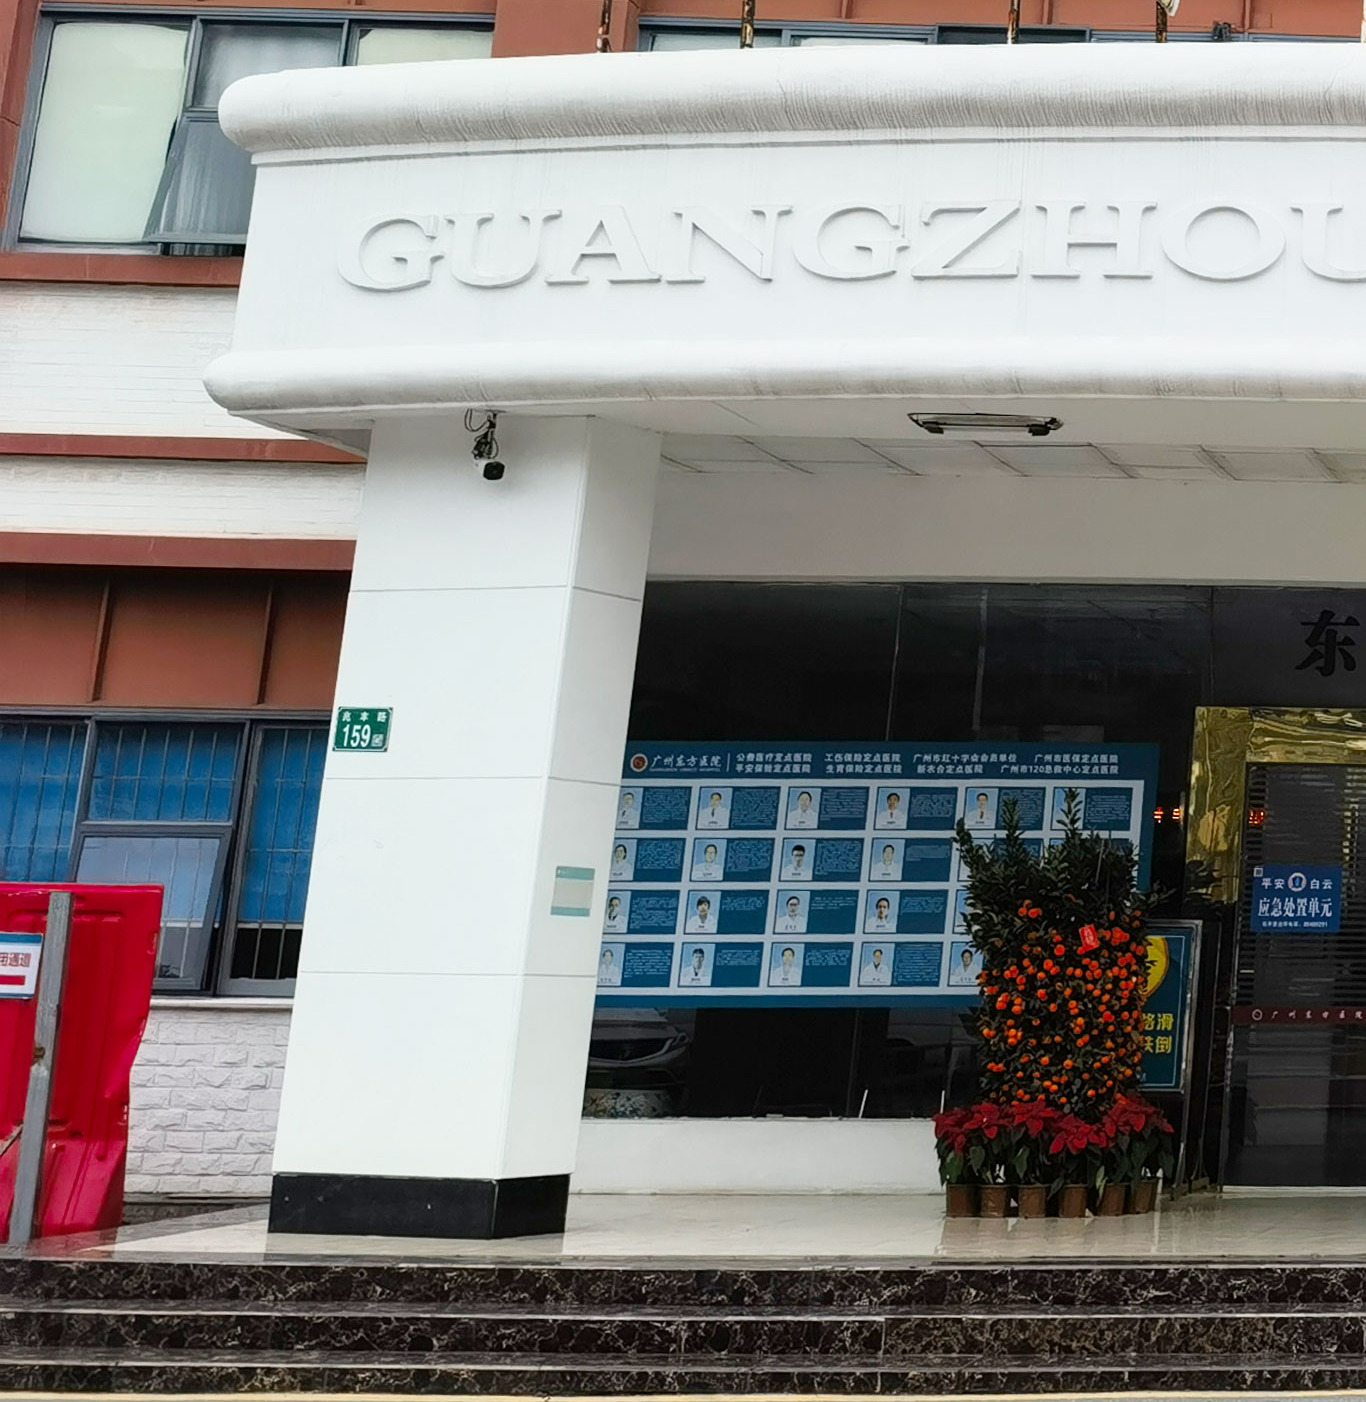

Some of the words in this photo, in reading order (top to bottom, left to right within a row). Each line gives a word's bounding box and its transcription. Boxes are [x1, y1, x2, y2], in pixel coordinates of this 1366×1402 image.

[343, 724, 371, 747] 159
[1261, 878, 1285, 889] 平安
[1310, 878, 1333, 889] 白云
[1257, 897, 1333, 918] 应急处置单元
